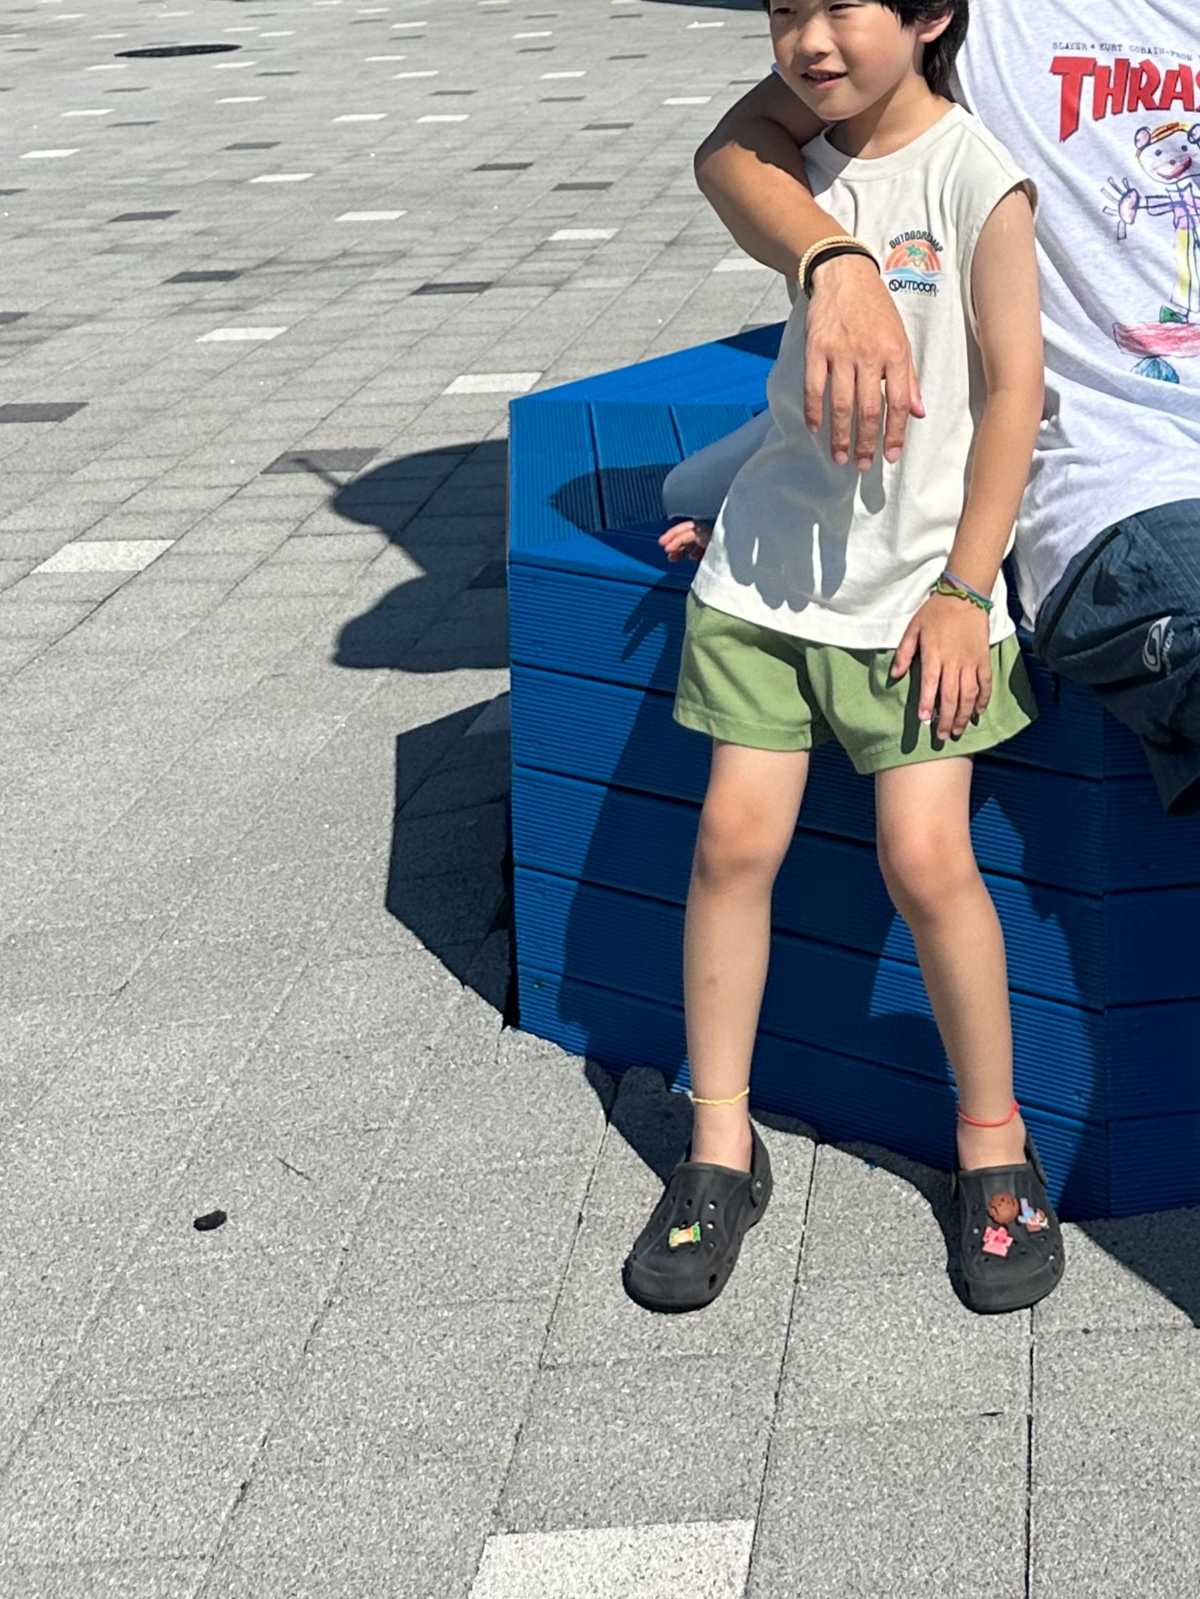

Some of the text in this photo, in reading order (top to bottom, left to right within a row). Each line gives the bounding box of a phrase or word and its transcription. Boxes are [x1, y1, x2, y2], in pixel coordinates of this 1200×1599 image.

[1052, 41, 1088, 51] SLAYER
[1099, 43, 1123, 52] KURT
[889, 279, 937, 297] OUTDOOR
